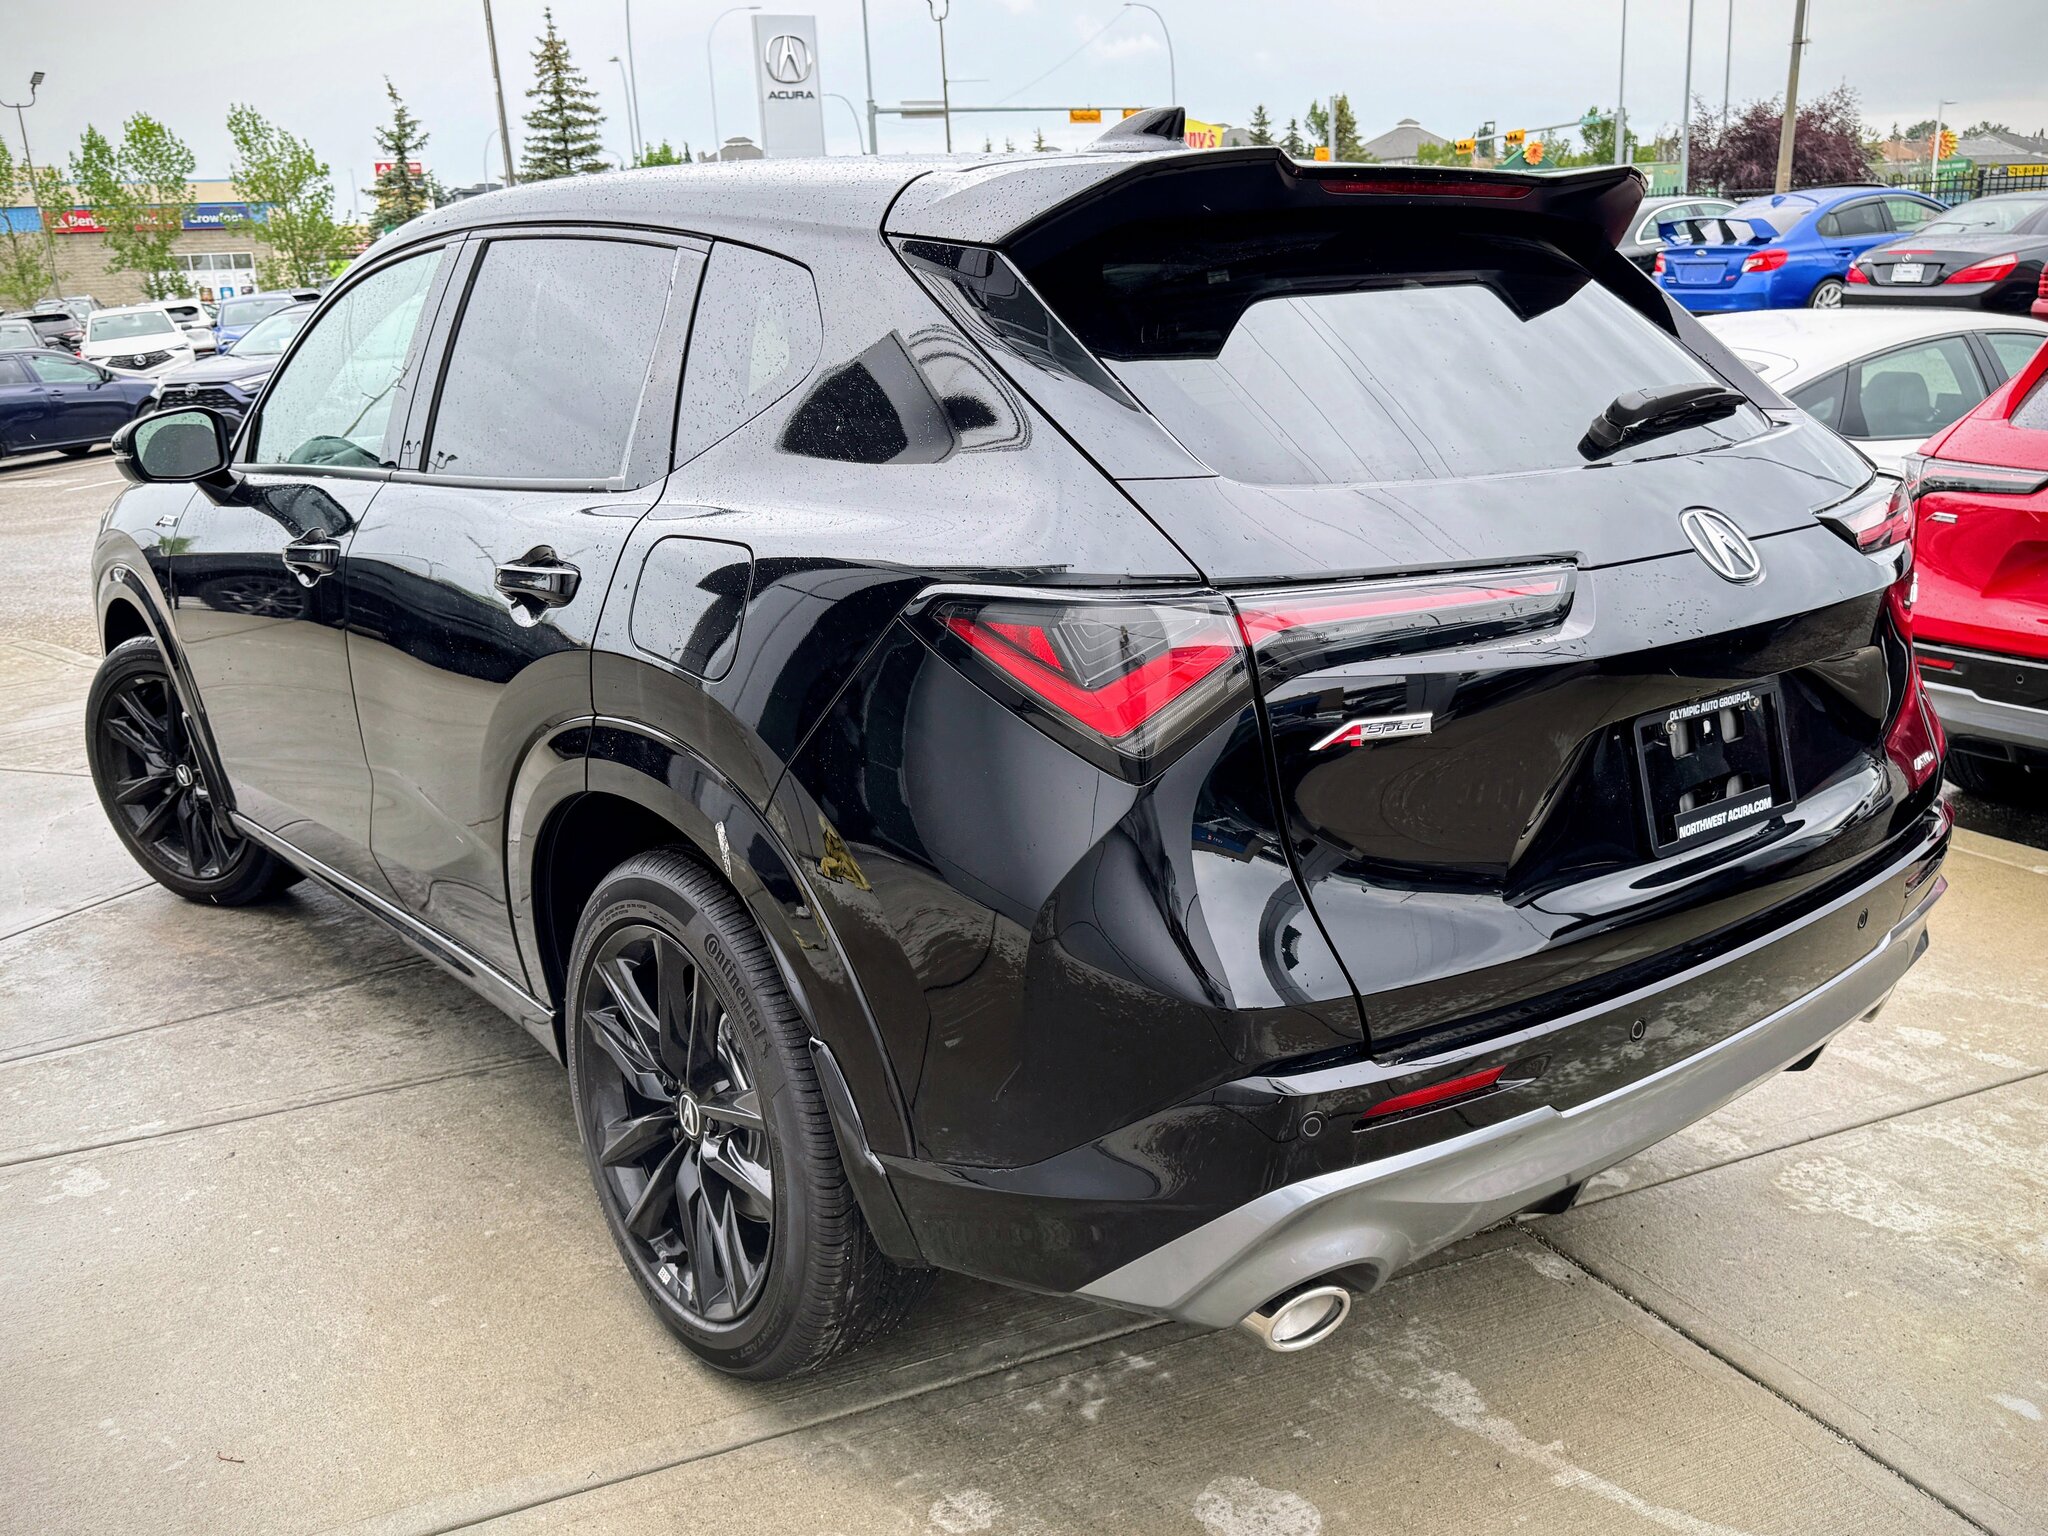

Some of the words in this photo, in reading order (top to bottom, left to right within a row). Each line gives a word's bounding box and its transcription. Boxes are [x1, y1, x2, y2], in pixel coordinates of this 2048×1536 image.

[768, 90, 815, 100] ACURA
[1669, 702, 1700, 721] OLYMPIC
[1700, 700, 1719, 713] AUTO
[1679, 812, 1727, 838] NORTHWEST
[1727, 797, 1772, 822] ACURA.COM
[704, 933, 766, 1037] Continental
